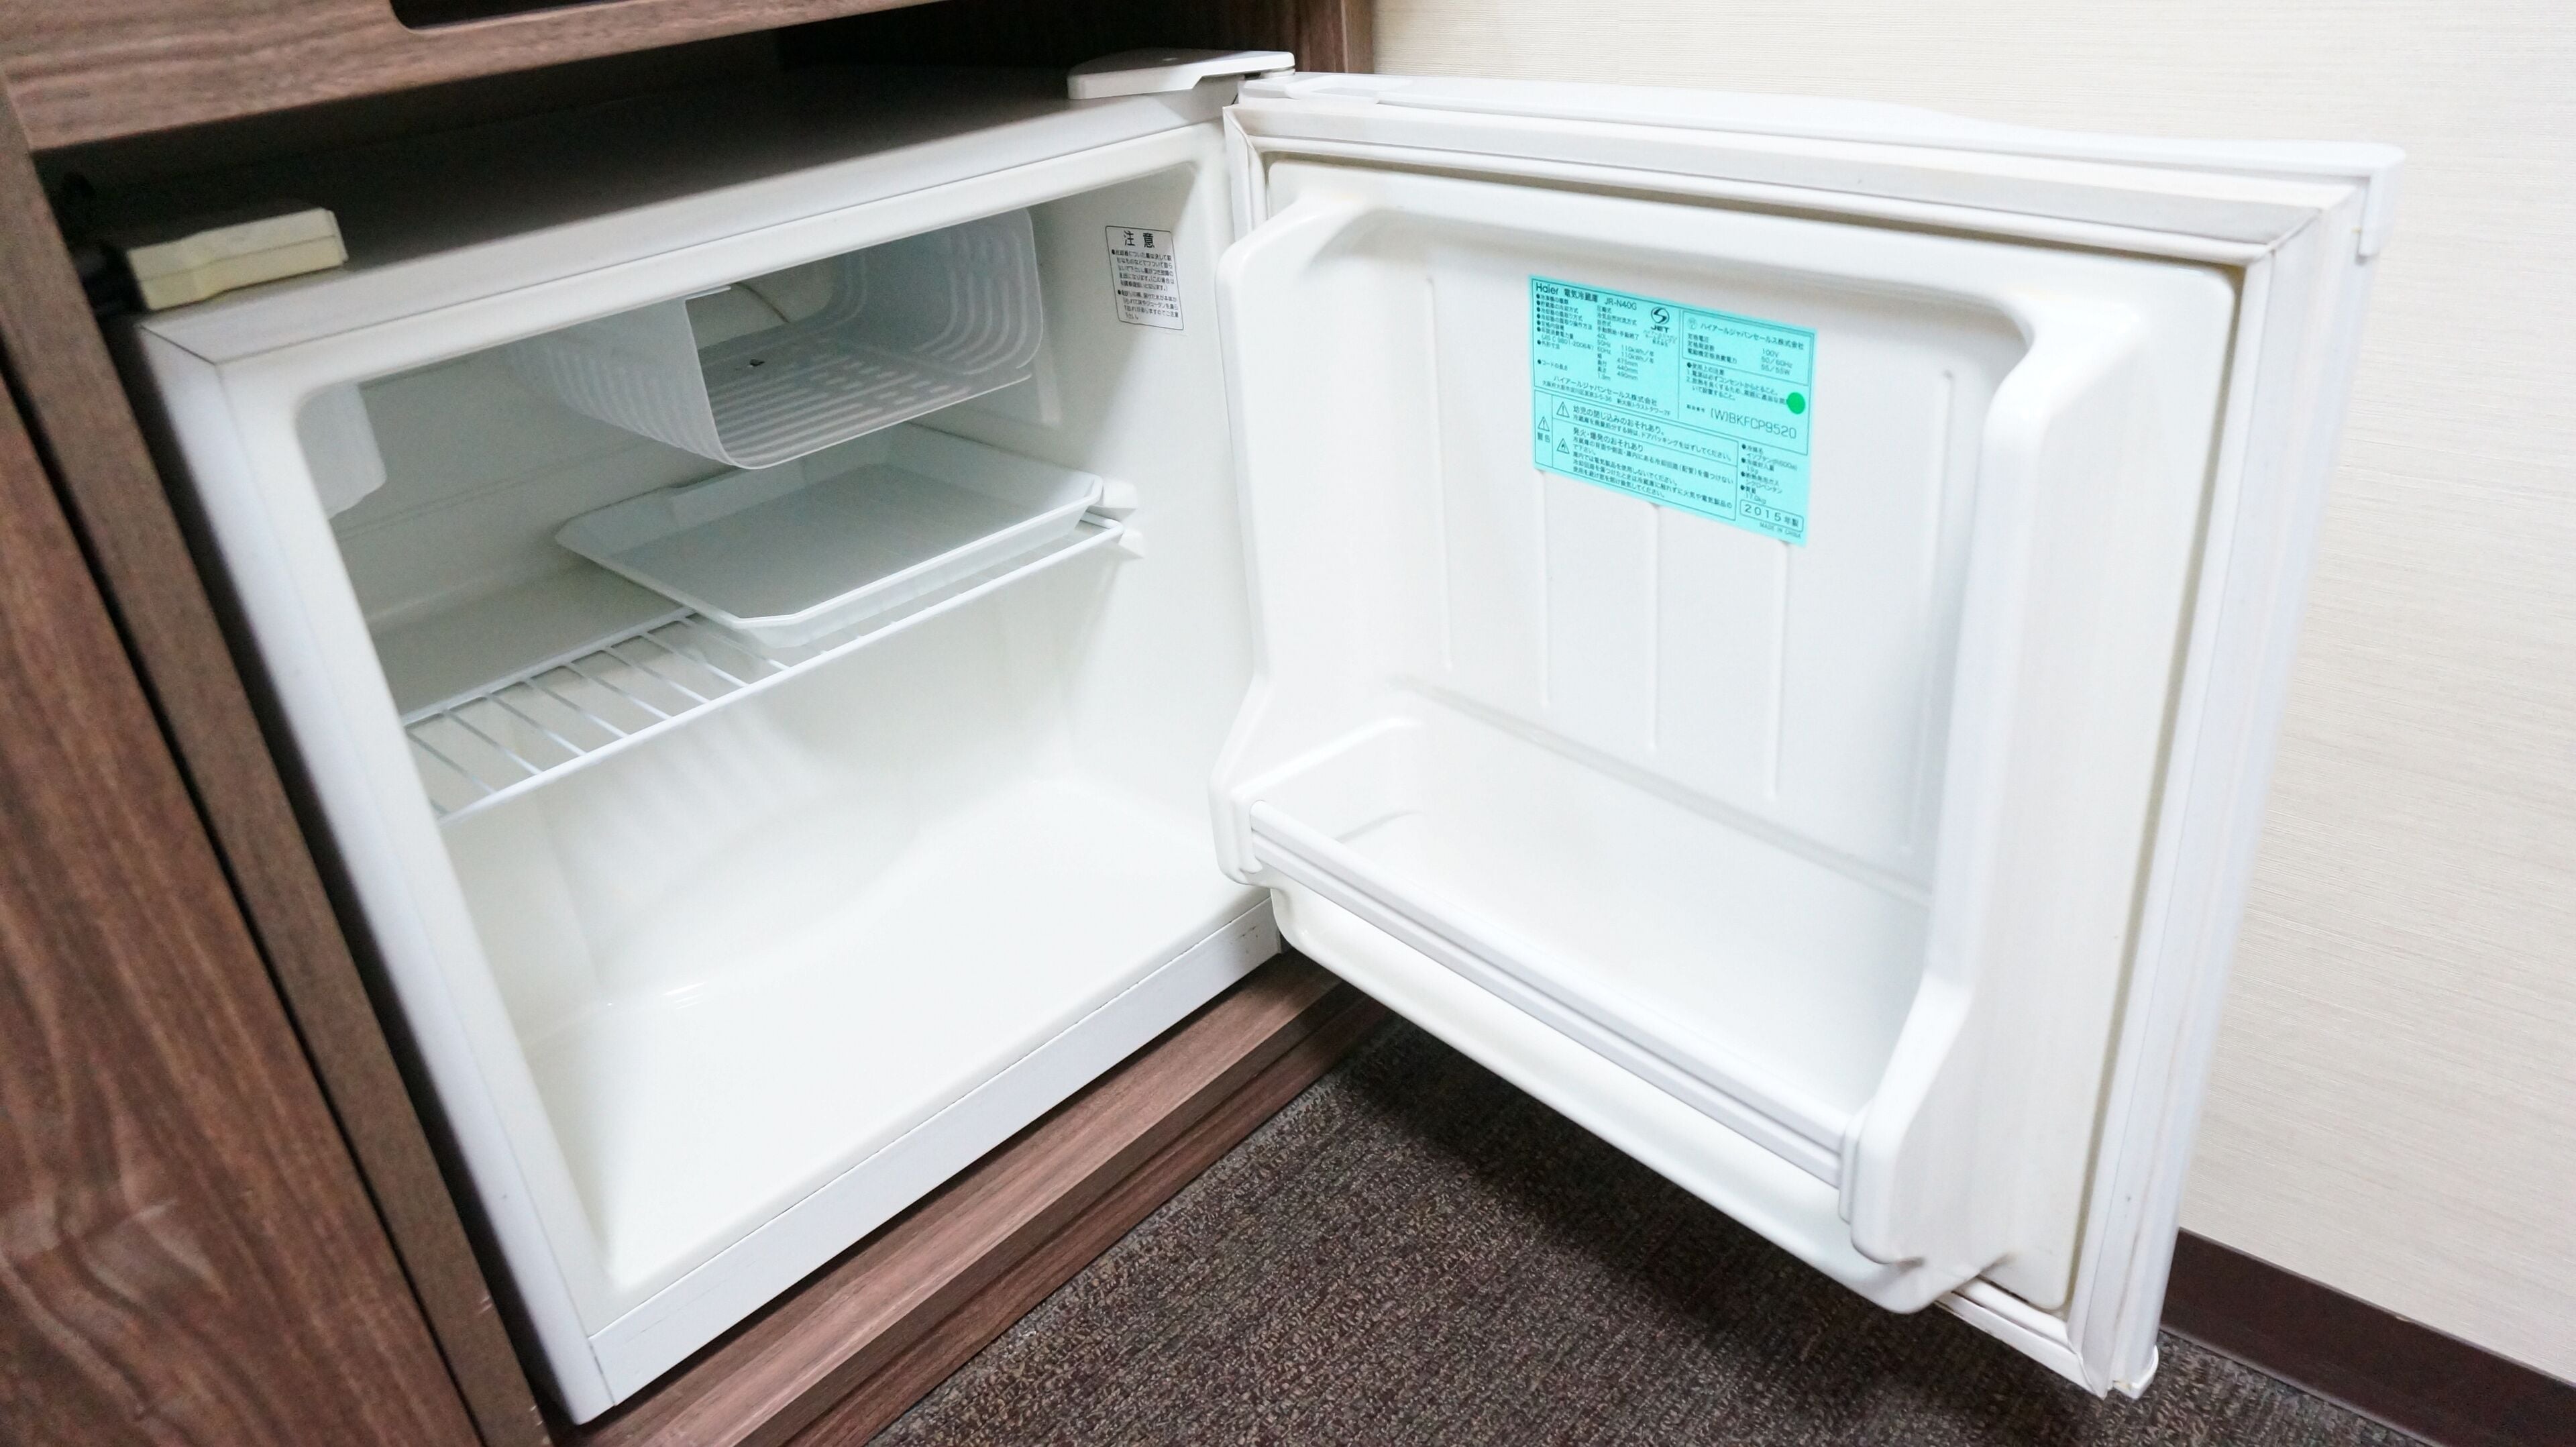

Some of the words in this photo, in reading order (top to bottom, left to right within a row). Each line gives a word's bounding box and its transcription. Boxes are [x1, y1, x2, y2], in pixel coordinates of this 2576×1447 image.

[1122, 229, 1155, 249] 注意
[1535, 280, 1559, 296] Haier
[1604, 296, 1638, 311] JR-N40G
[1650, 323, 1670, 334] JET
[1762, 347, 1780, 358] 100V
[1553, 374, 1658, 407] ハイアールジャパンセールス株式会社
[1710, 407, 1797, 439] (W)BKFCP9520
[1744, 502, 1799, 528] 2015年製
